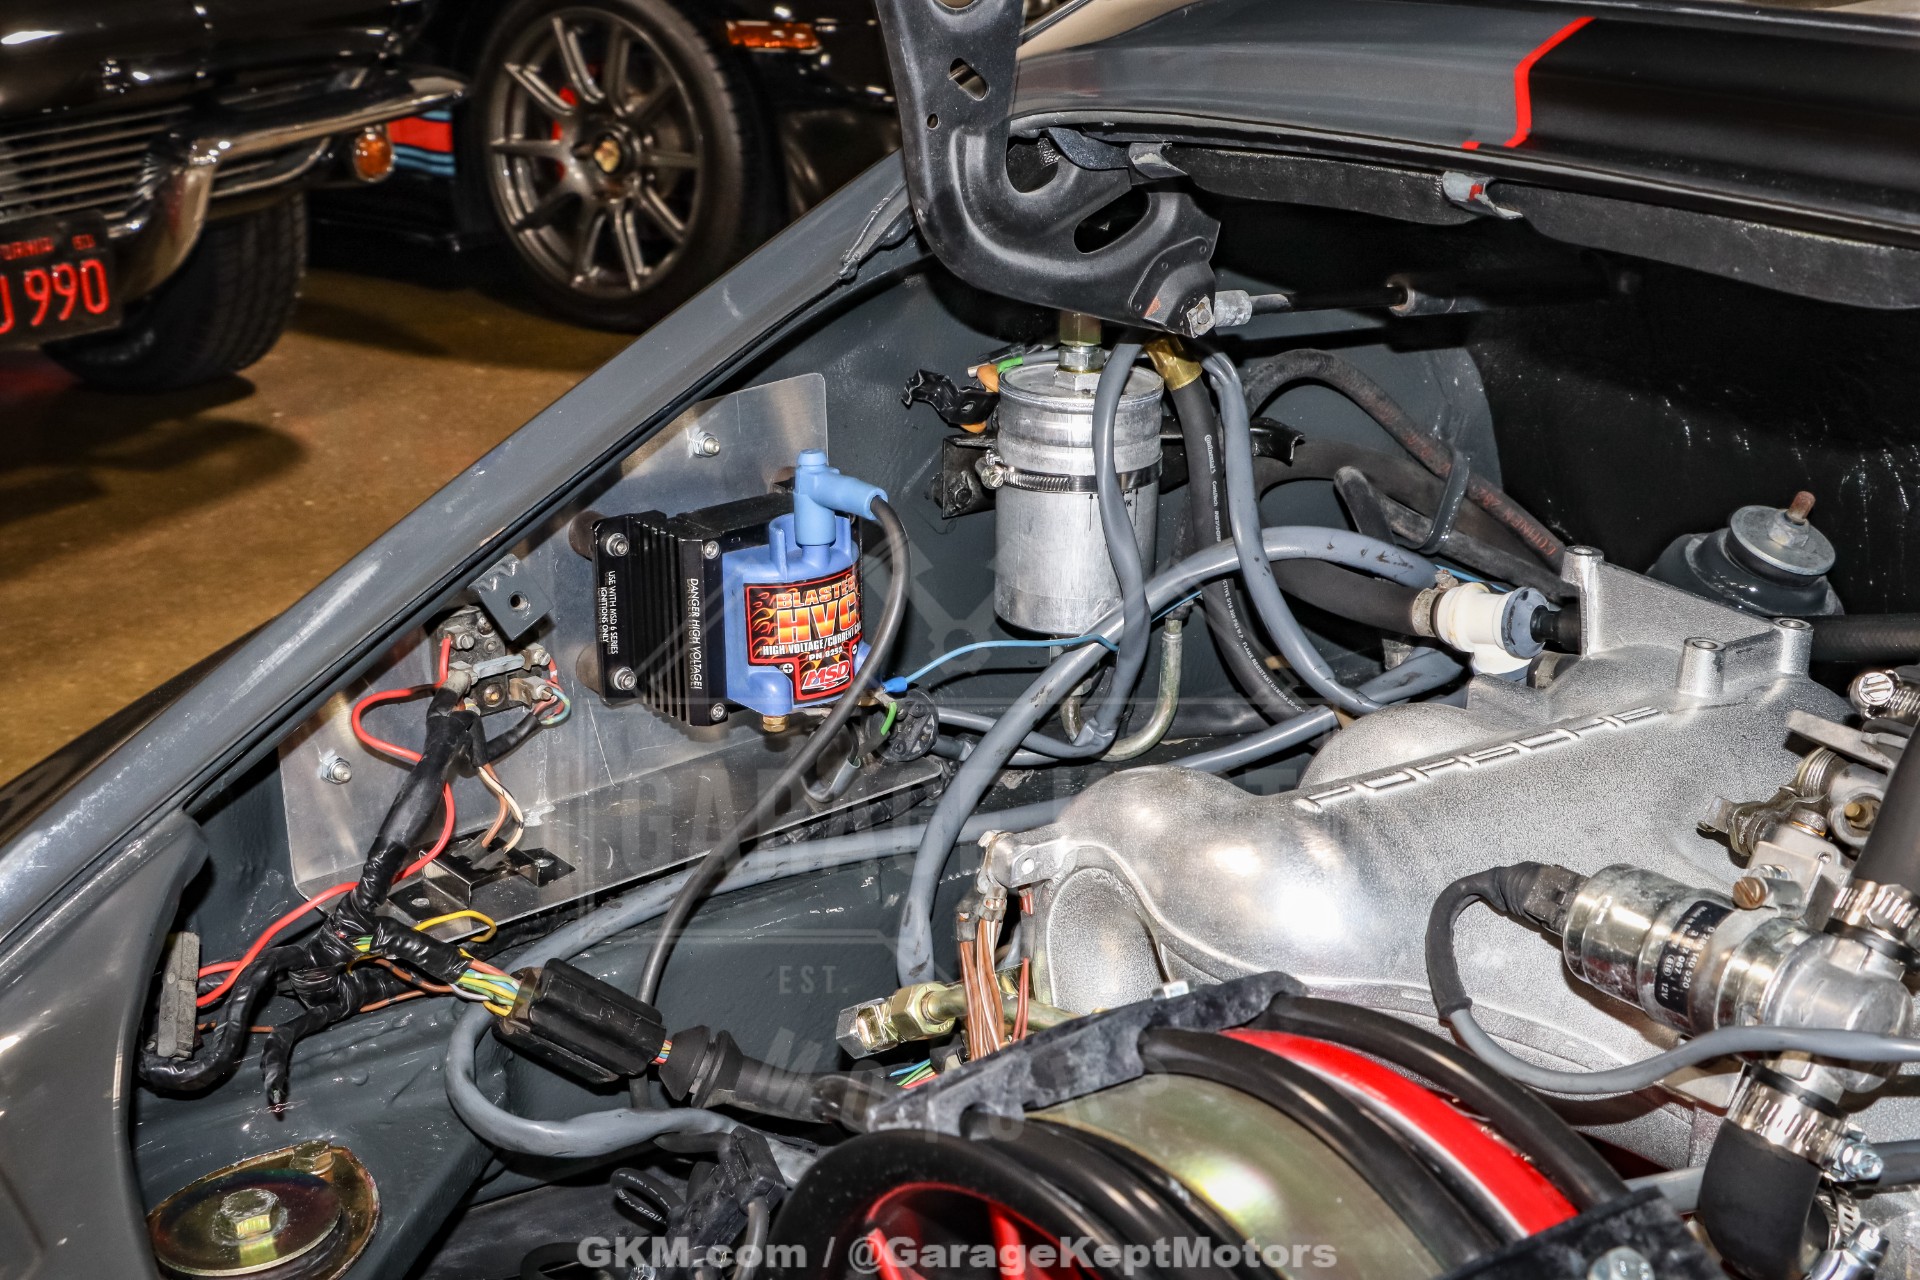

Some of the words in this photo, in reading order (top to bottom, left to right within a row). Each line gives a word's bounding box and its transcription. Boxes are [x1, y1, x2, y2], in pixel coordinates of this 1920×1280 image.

[24, 259, 110, 326] 990
[608, 570, 616, 586] USE
[609, 586, 617, 607] WITH
[690, 578, 700, 617] DANGER
[776, 575, 856, 609] BLASTER
[600, 587, 608, 623] IGNITIONS
[610, 608, 618, 625] MSD
[777, 592, 857, 644] HVC
[611, 631, 619, 655] SERIES
[692, 619, 701, 644] HIGH
[762, 645, 786, 655] HIGH
[788, 628, 854, 654] VOLTAGE/CURRENT
[809, 652, 823, 660] PN
[1242, 641, 1254, 660] FLAME
[1251, 658, 1273, 685] RESISTANT
[802, 660, 850, 690] MSD
[1675, 955, 1686, 975] 067
[1661, 983, 1669, 1000] 12V
[1682, 971, 1692, 989] 520
